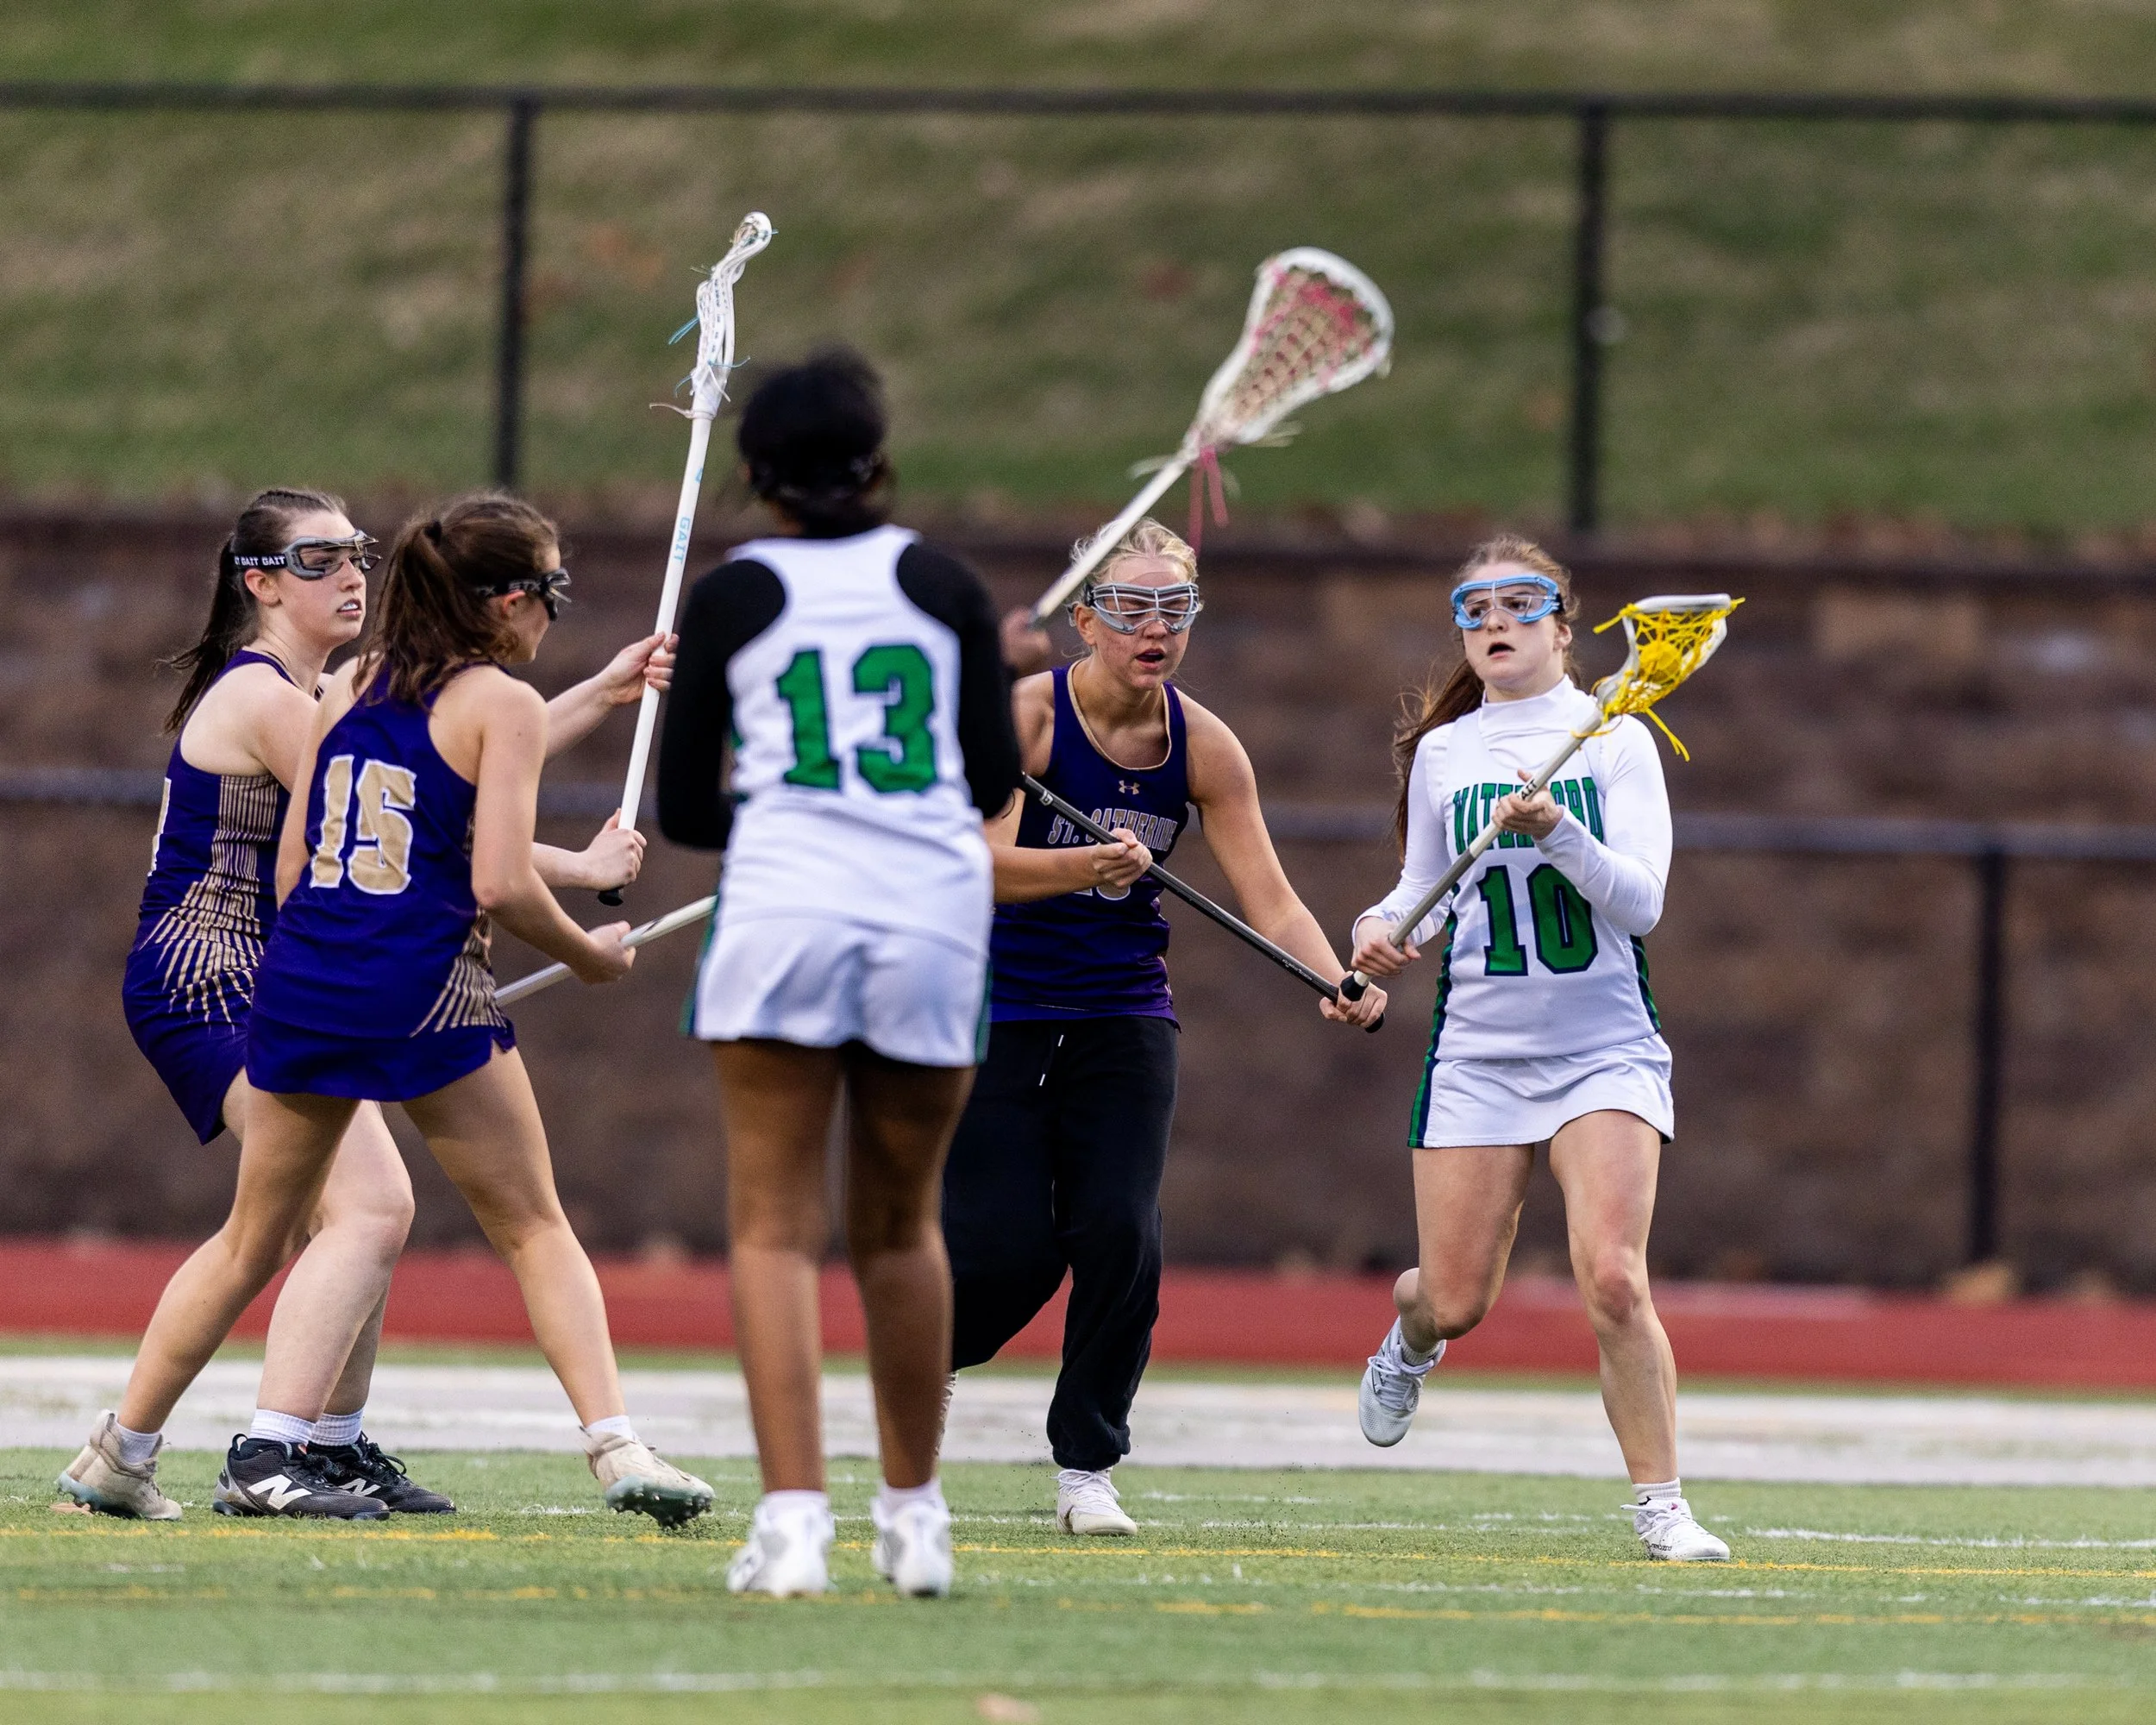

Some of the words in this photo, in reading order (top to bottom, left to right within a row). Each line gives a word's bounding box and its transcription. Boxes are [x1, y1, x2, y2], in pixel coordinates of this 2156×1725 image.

[241, 556, 259, 566] GAIT
[261, 555, 285, 566] GAIT
[674, 517, 691, 564] GAIT
[775, 644, 937, 793] 13
[309, 754, 417, 894] 15
[1520, 779, 1537, 800] AIT
[1476, 863, 1598, 976] 10
